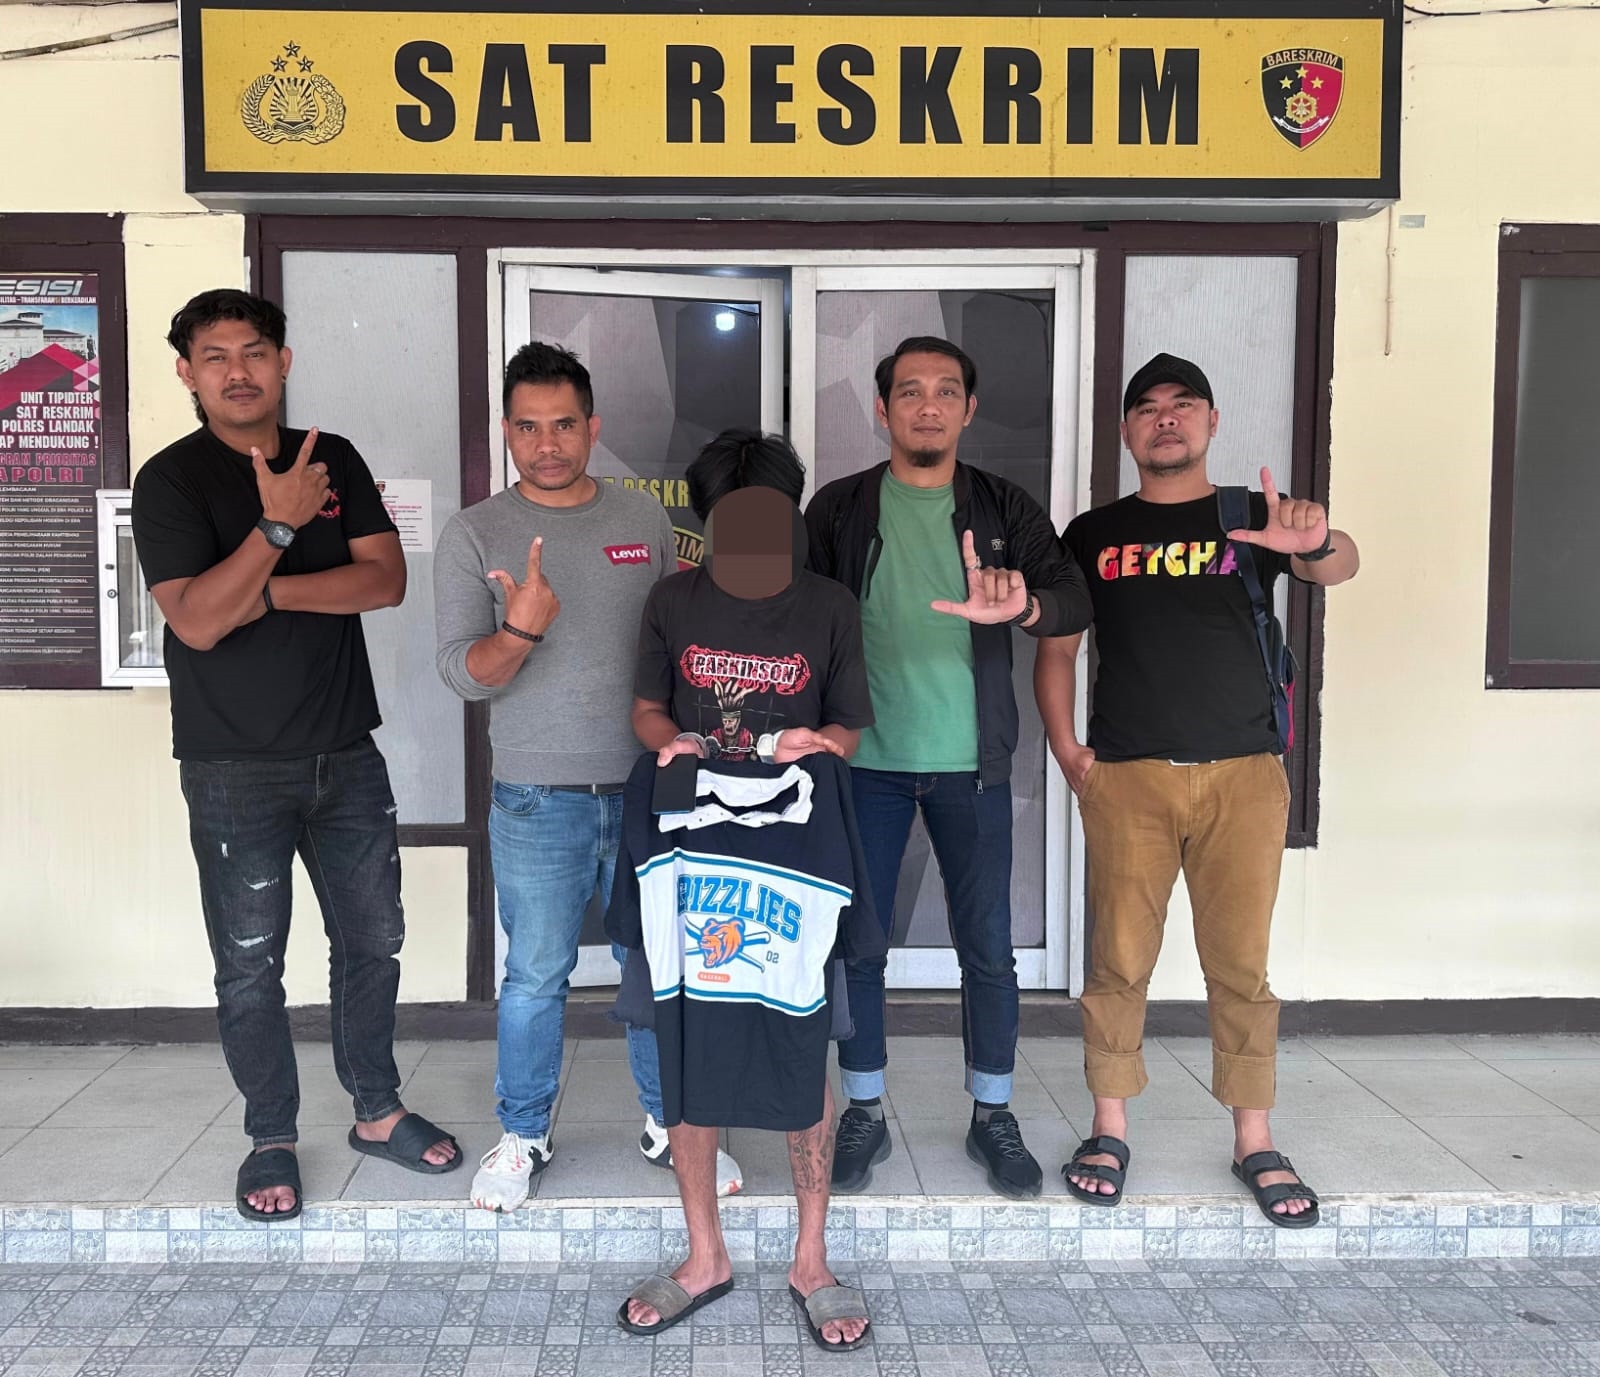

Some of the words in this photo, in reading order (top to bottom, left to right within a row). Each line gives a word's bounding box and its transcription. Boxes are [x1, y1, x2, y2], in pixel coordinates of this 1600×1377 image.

[1266, 49, 1338, 67] BARESKRIM
[394, 40, 606, 143] SAT
[665, 43, 1199, 146] RESKRIM
[20, 392, 44, 403] UNIT
[48, 392, 93, 404] TIPIDTER
[16, 406, 38, 419] SAT
[43, 406, 94, 419] RESKRIM
[2, 420, 45, 433] POLRES
[49, 420, 94, 433] LANDAK
[18, 435, 90, 449] MENDUKUNG
[35, 453, 97, 467] PRIORITAS
[1097, 541, 1239, 581] GETCHA
[693, 653, 797, 685] PARKINSON
[766, 950, 780, 964] 02
